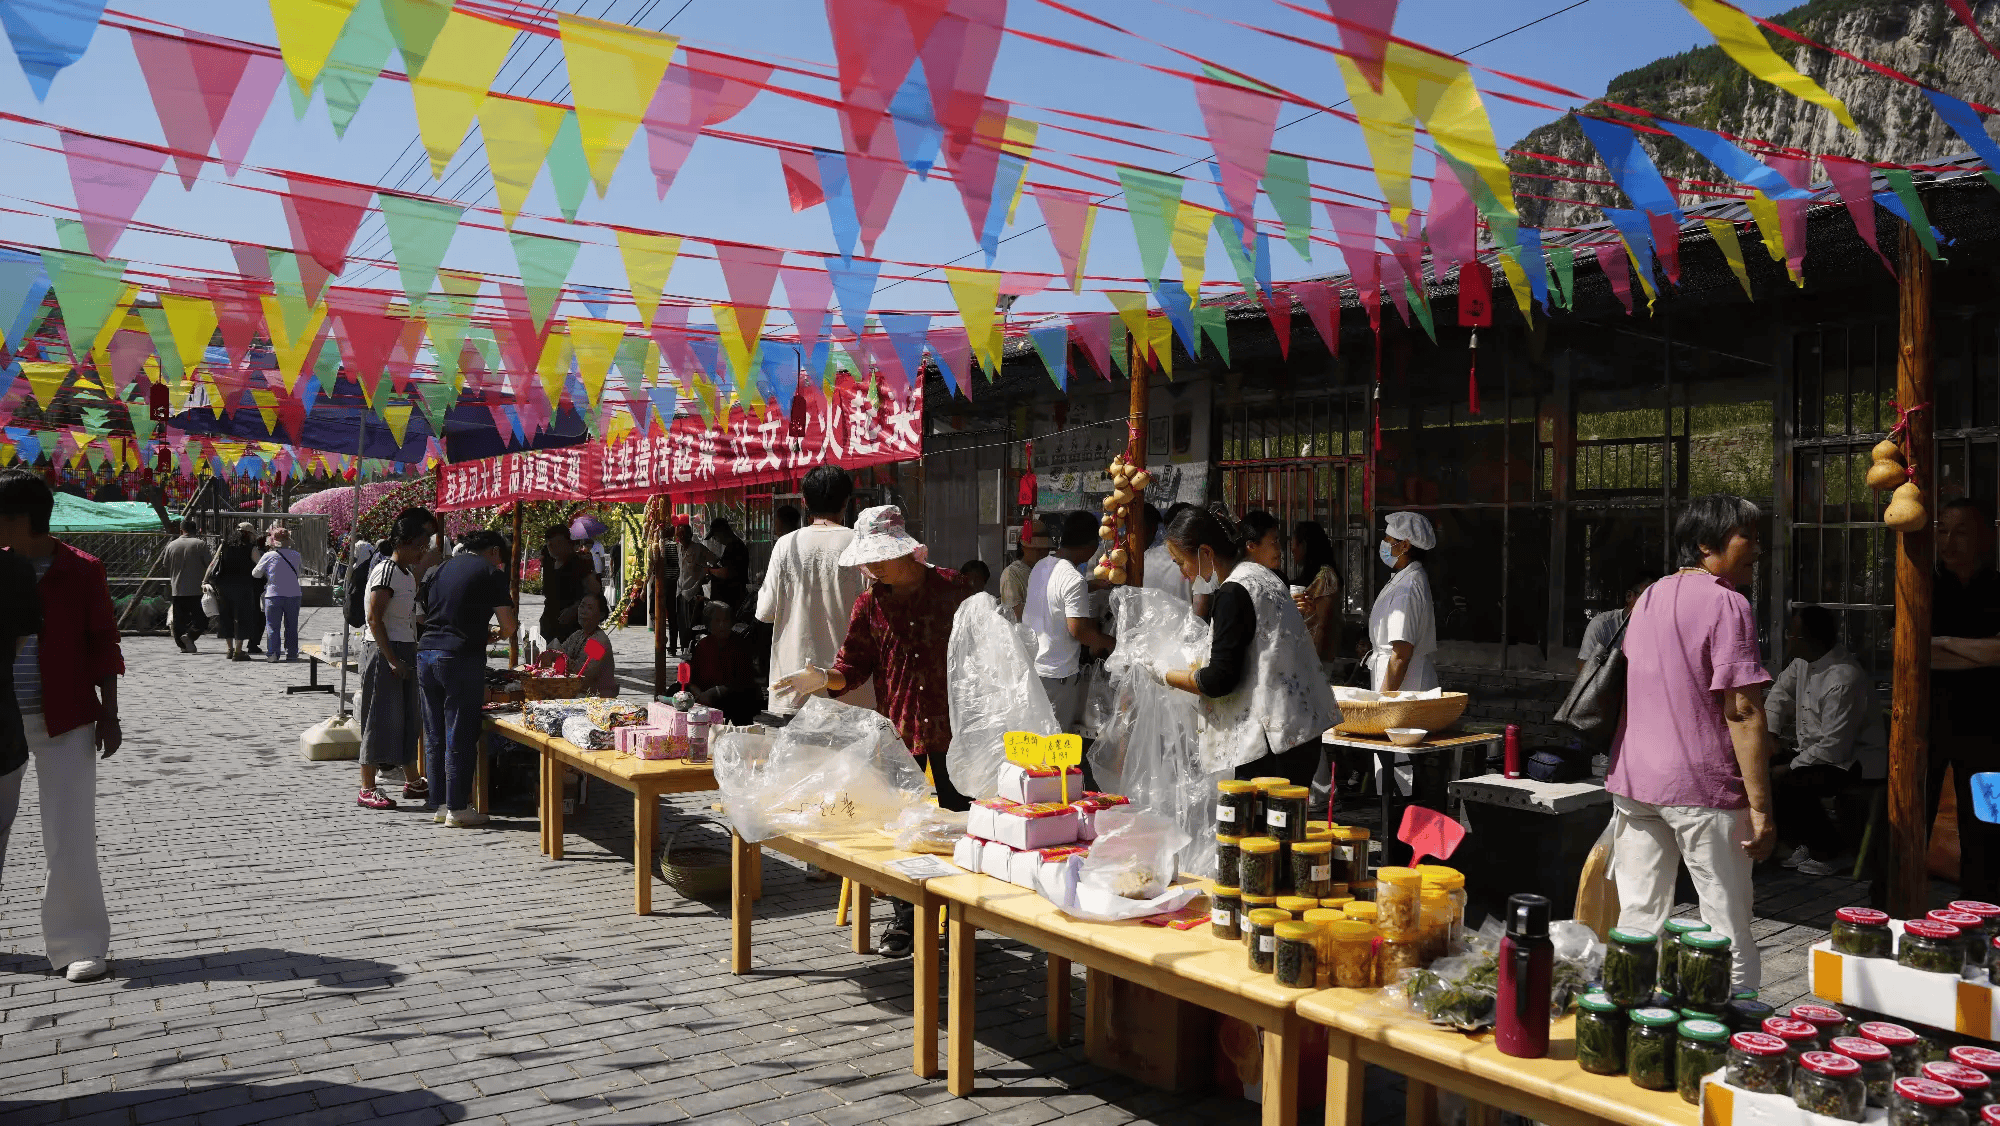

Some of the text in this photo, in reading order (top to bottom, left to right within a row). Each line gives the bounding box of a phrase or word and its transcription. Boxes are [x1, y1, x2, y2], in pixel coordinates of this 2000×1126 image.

[602, 429, 720, 489] 让非遗活起来
[730, 387, 922, 476] 让文化火起来
